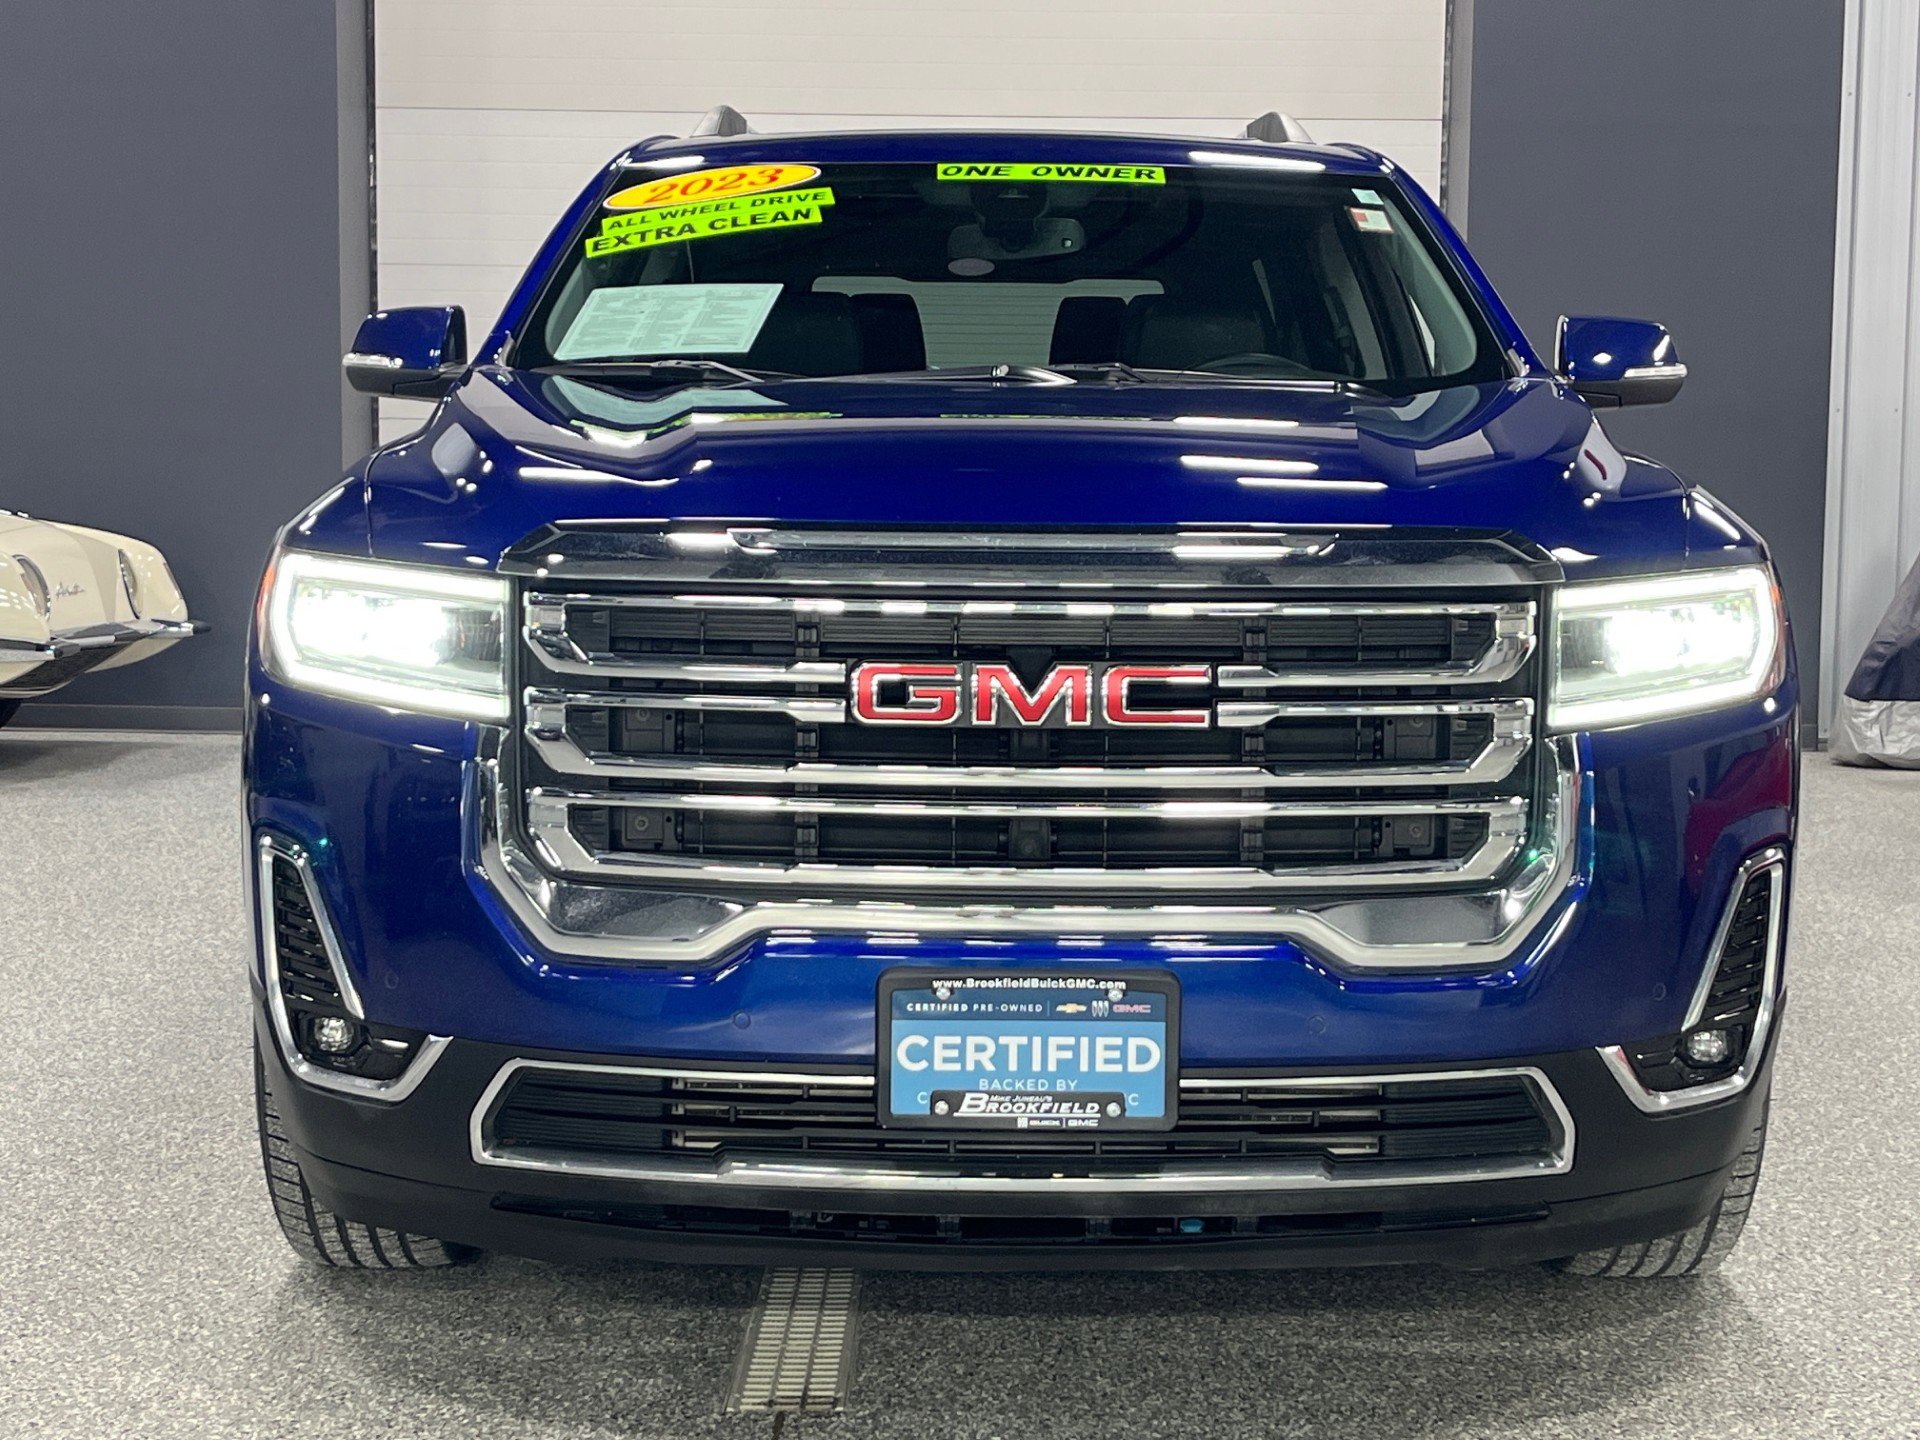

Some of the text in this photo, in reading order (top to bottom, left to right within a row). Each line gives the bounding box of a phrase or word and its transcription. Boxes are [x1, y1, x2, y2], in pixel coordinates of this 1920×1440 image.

[941, 165, 1157, 179] ONE OWNER
[642, 168, 784, 204] 2023
[608, 191, 827, 231] ALL WHEEL DRIVE
[592, 207, 812, 252] EXTRA CLEAN
[851, 662, 1211, 728] GMC
[932, 977, 1126, 990] www.BrookfieldBuickGMC.com
[906, 1003, 1151, 1013] CERTIFIED PRE-OWNED GMC
[897, 1034, 1161, 1073] CERTIFIED
[979, 1078, 1078, 1091] BACKED BY
[958, 1092, 1100, 1114] BROOKFIELD
[1067, 1119, 1099, 1127] GMC
